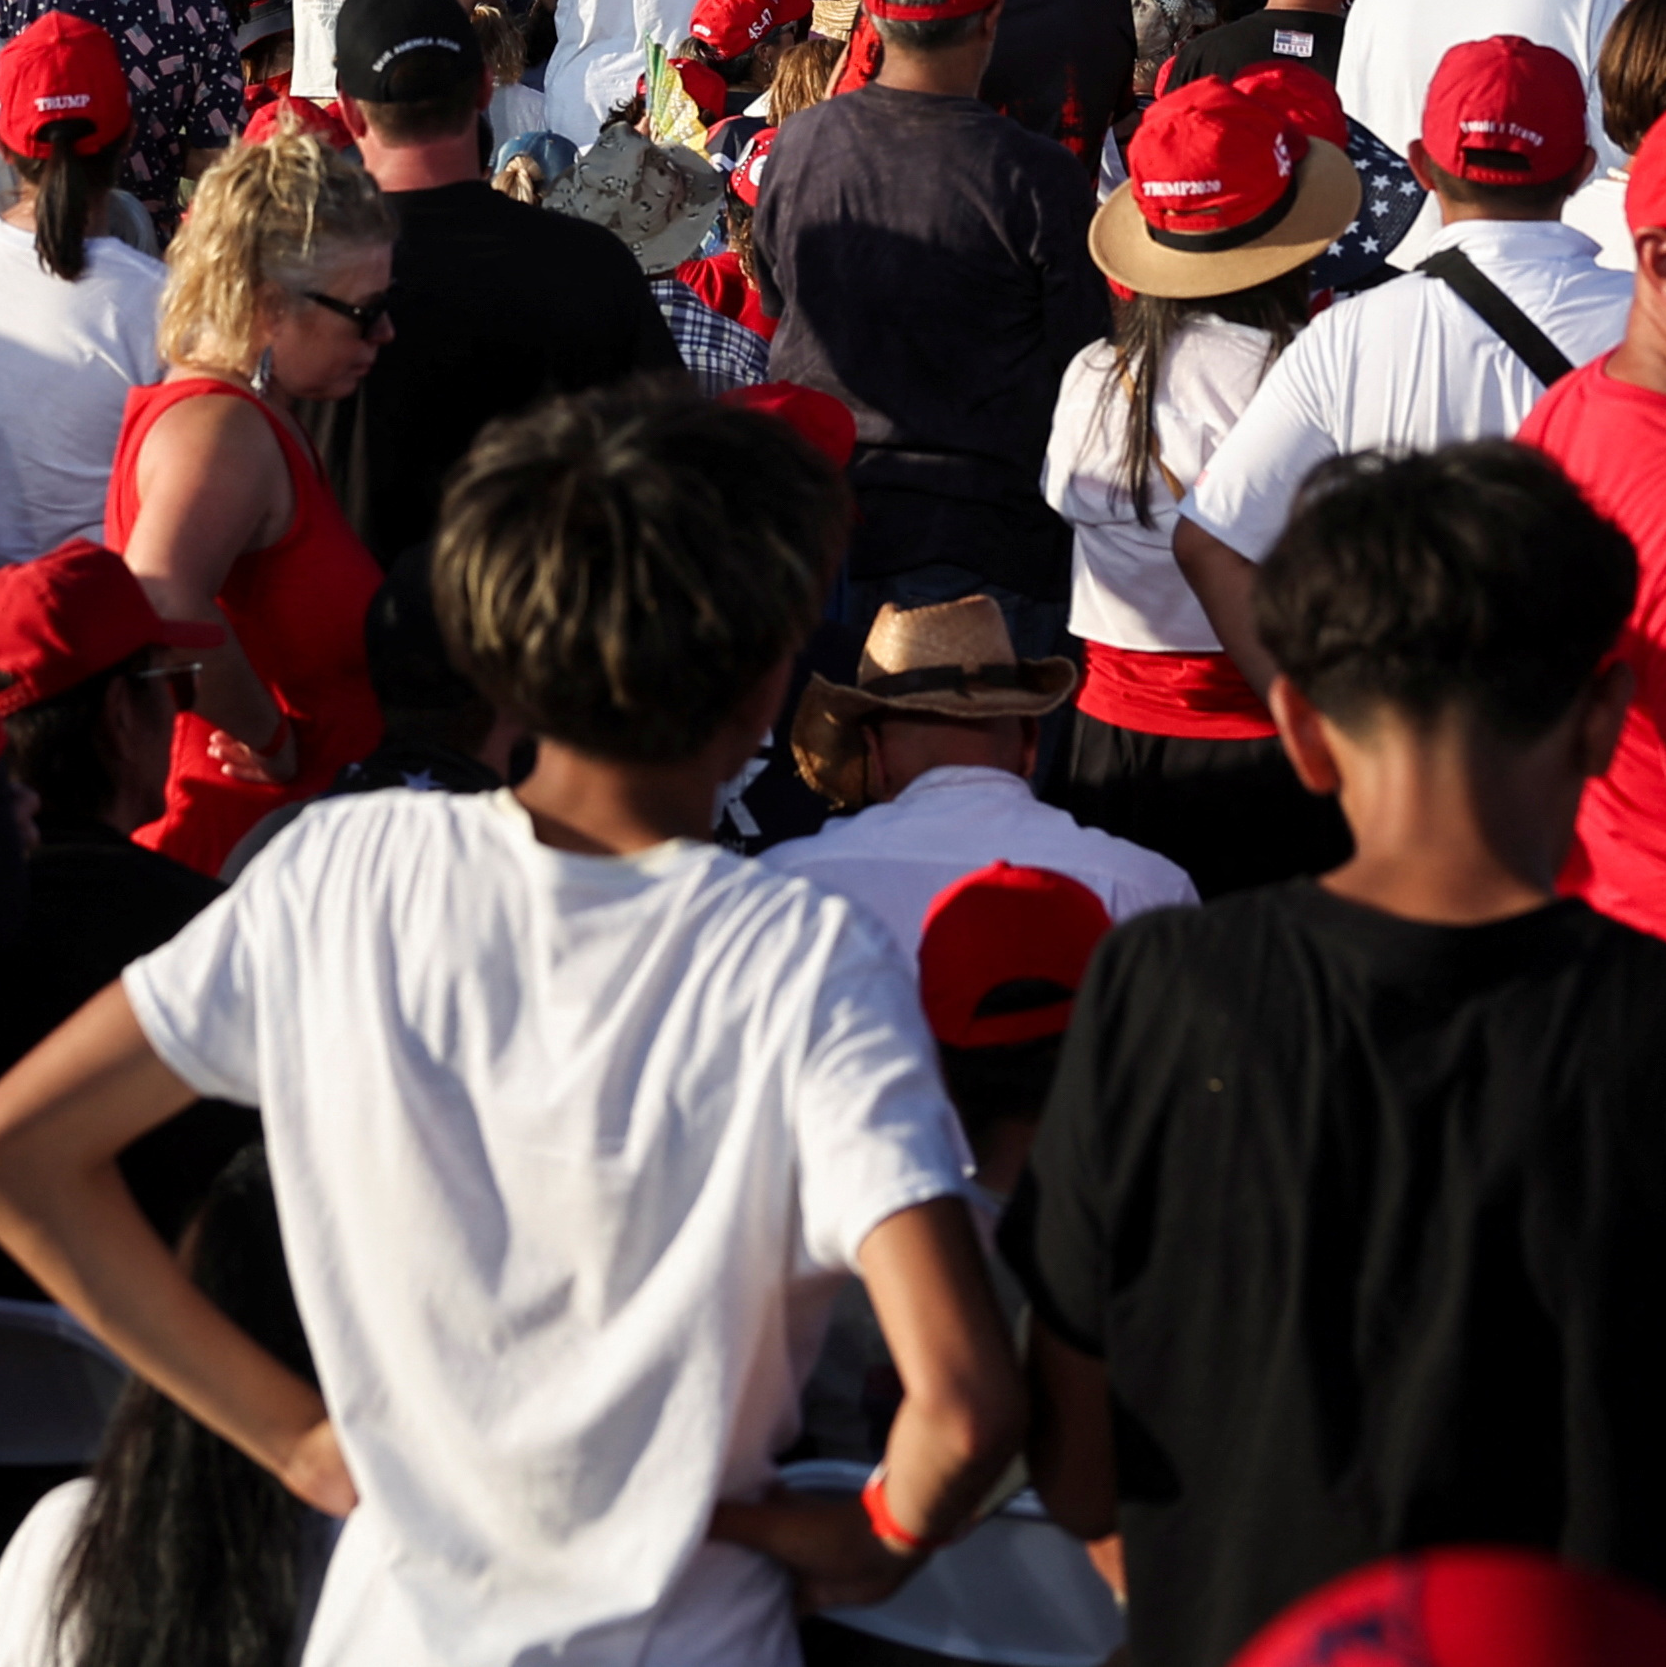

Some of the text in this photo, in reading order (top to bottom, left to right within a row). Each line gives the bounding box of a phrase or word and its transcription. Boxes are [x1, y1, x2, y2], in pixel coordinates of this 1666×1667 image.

[747, 8, 772, 39] 45-47
[394, 37, 434, 55] AMERICA
[33, 93, 91, 113] TRUMP
[1141, 180, 1223, 198] TRUMP2020
